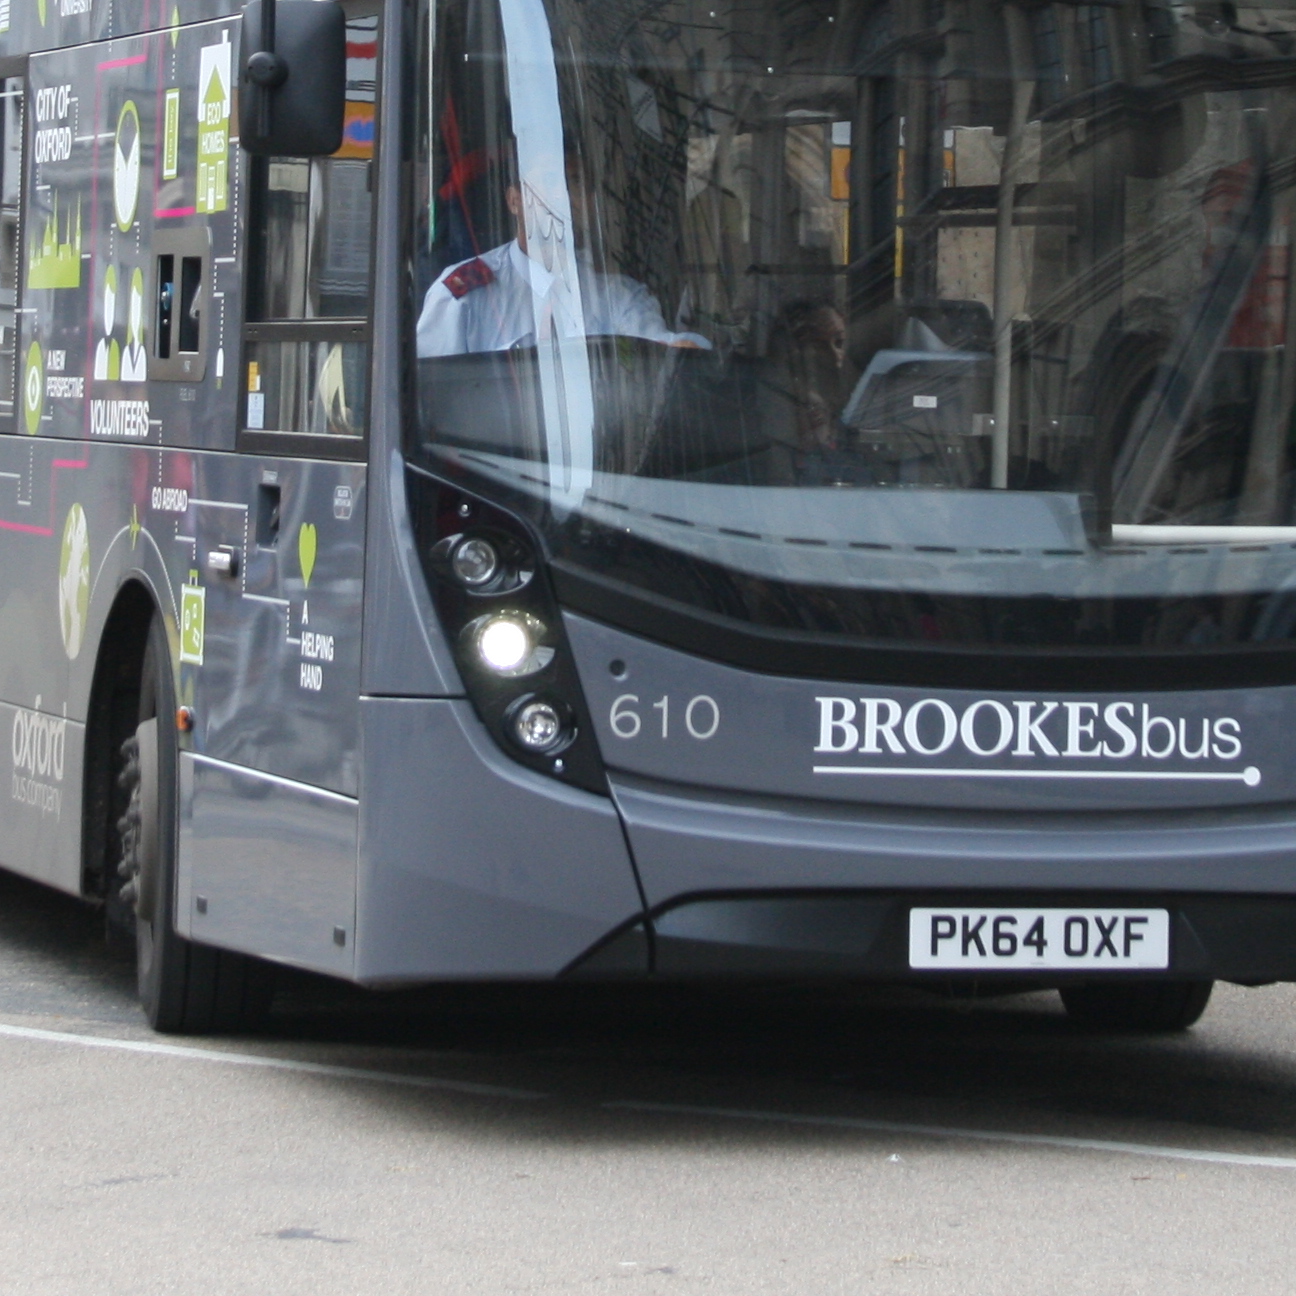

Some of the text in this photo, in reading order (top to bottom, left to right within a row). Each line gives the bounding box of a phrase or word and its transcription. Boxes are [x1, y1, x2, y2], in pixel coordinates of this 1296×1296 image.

[36, 84, 72, 122] CITY OF
[207, 102, 222, 125] ECO
[35, 126, 72, 164] OXFORD
[202, 130, 224, 154] HOMES
[46, 376, 84, 398] PERSPECTIVE
[90, 399, 150, 437] VOLUNTEERS
[152, 486, 188, 512] GO ABROAD
[301, 599, 308, 625] A
[301, 631, 334, 662] HELPING
[300, 663, 323, 691] HAND
[12, 694, 67, 781] oxford
[609, 694, 1242, 758] 610 BROOKESbus
[929, 915, 1148, 959] PK64 OXF
